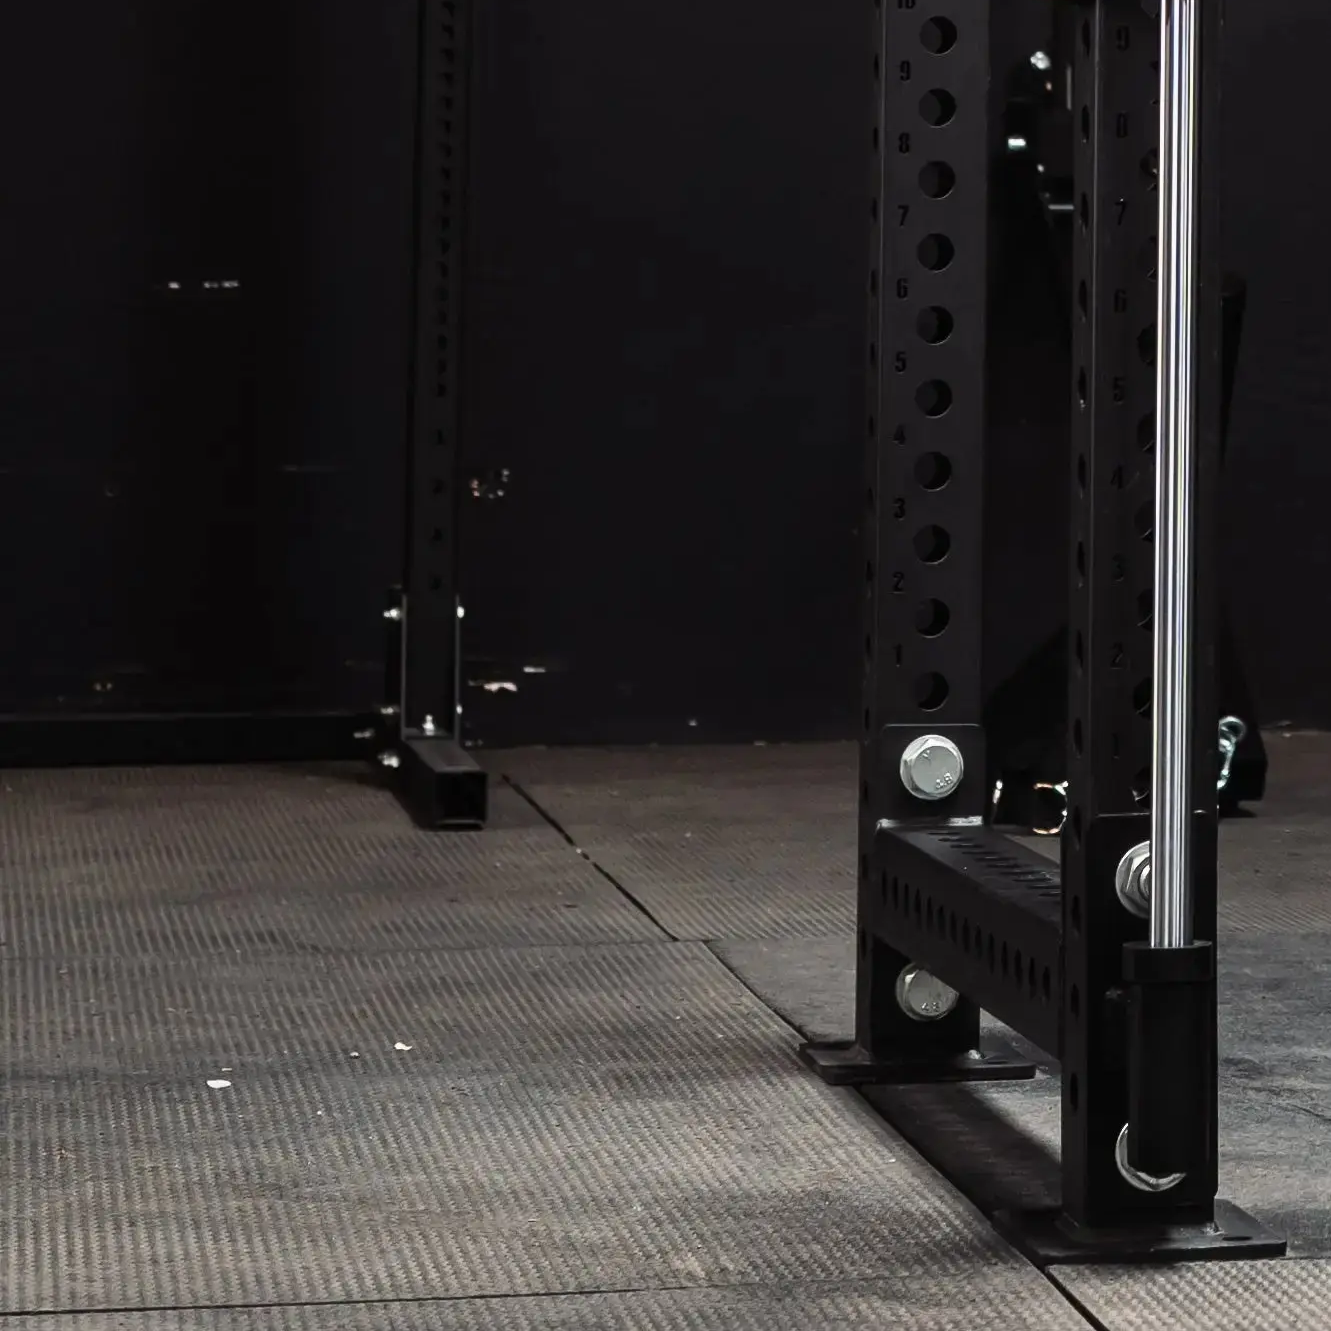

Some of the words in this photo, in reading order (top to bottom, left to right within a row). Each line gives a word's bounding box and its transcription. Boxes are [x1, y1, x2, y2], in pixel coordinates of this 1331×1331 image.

[1115, 25, 1130, 52] 9
[899, 60, 911, 82] 9
[897, 132, 911, 154] 8
[897, 204, 910, 227] 7
[1114, 200, 1129, 227] 7
[896, 277, 909, 299] 6
[1113, 288, 1128, 314] 6
[894, 351, 907, 373] 5
[1112, 376, 1127, 402] 5
[893, 497, 906, 519] 3
[892, 571, 905, 592] 2
